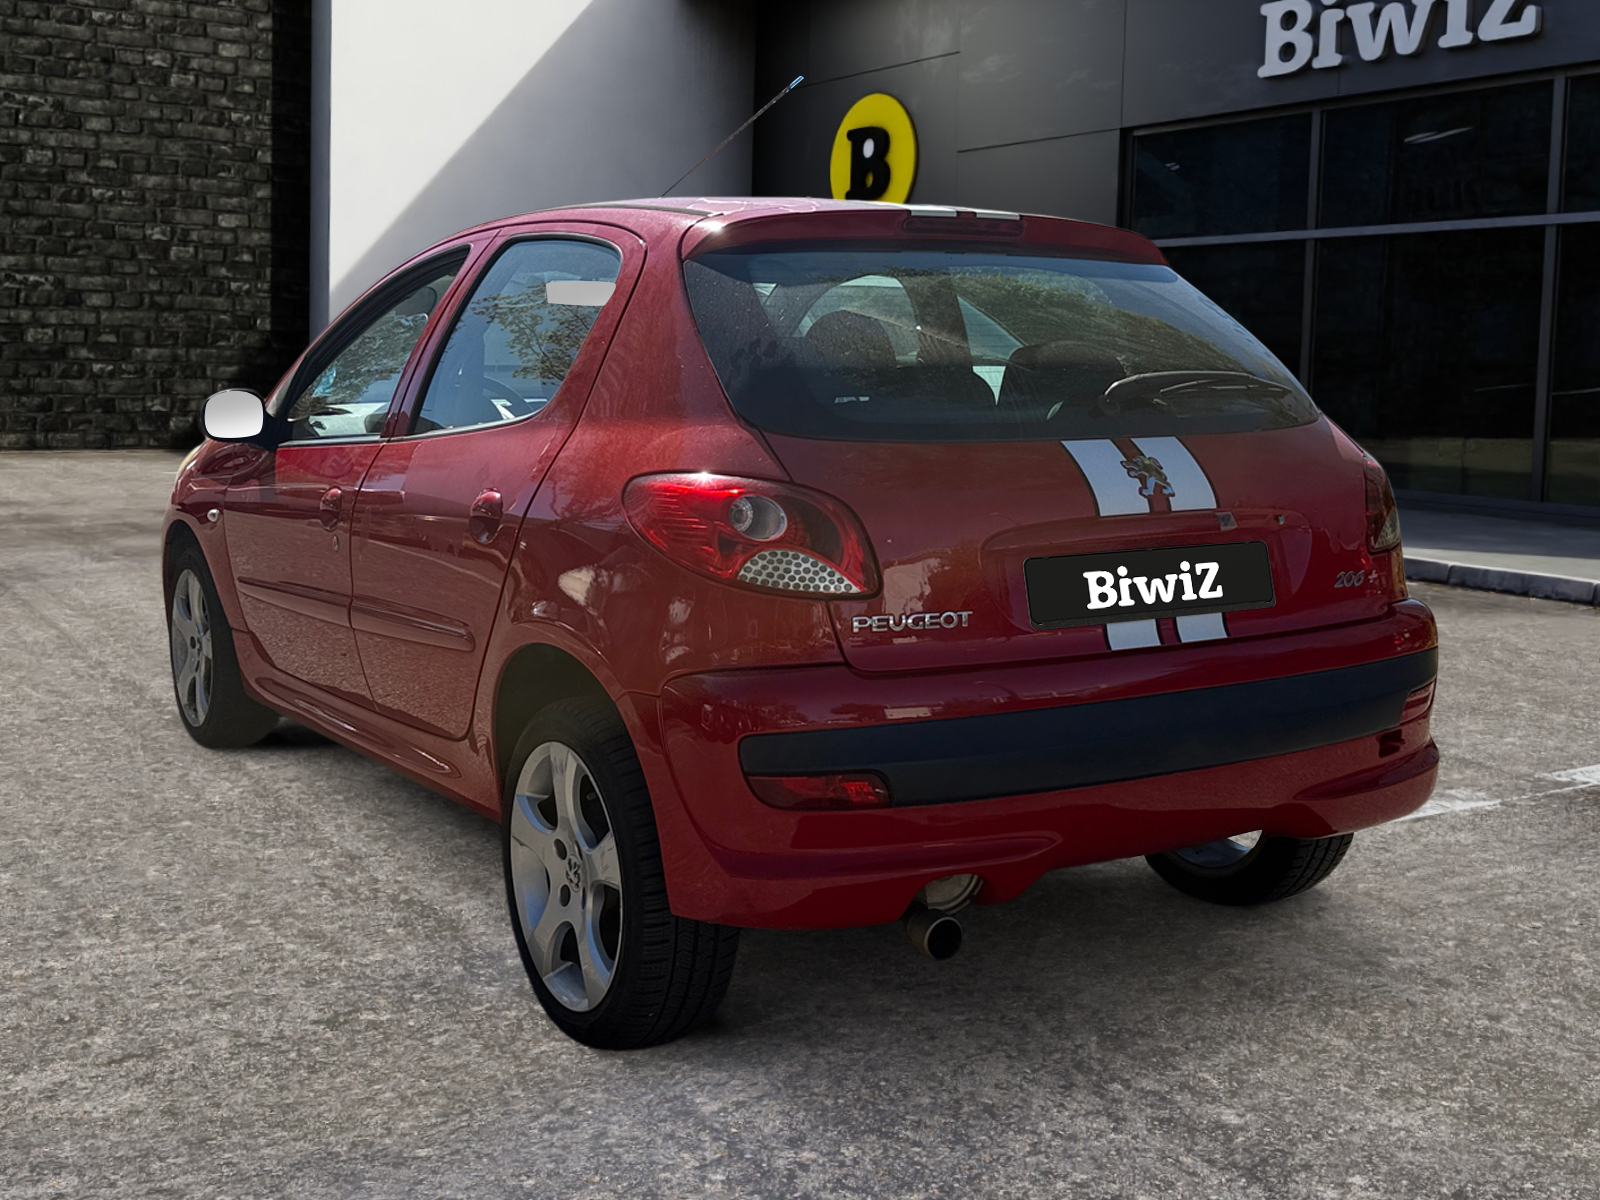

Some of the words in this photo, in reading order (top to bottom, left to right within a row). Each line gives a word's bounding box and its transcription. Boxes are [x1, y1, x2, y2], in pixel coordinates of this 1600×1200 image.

[845, 126, 891, 201] B
[1083, 561, 1223, 609] BiwiZ
[852, 611, 973, 633] PEUGEOT
